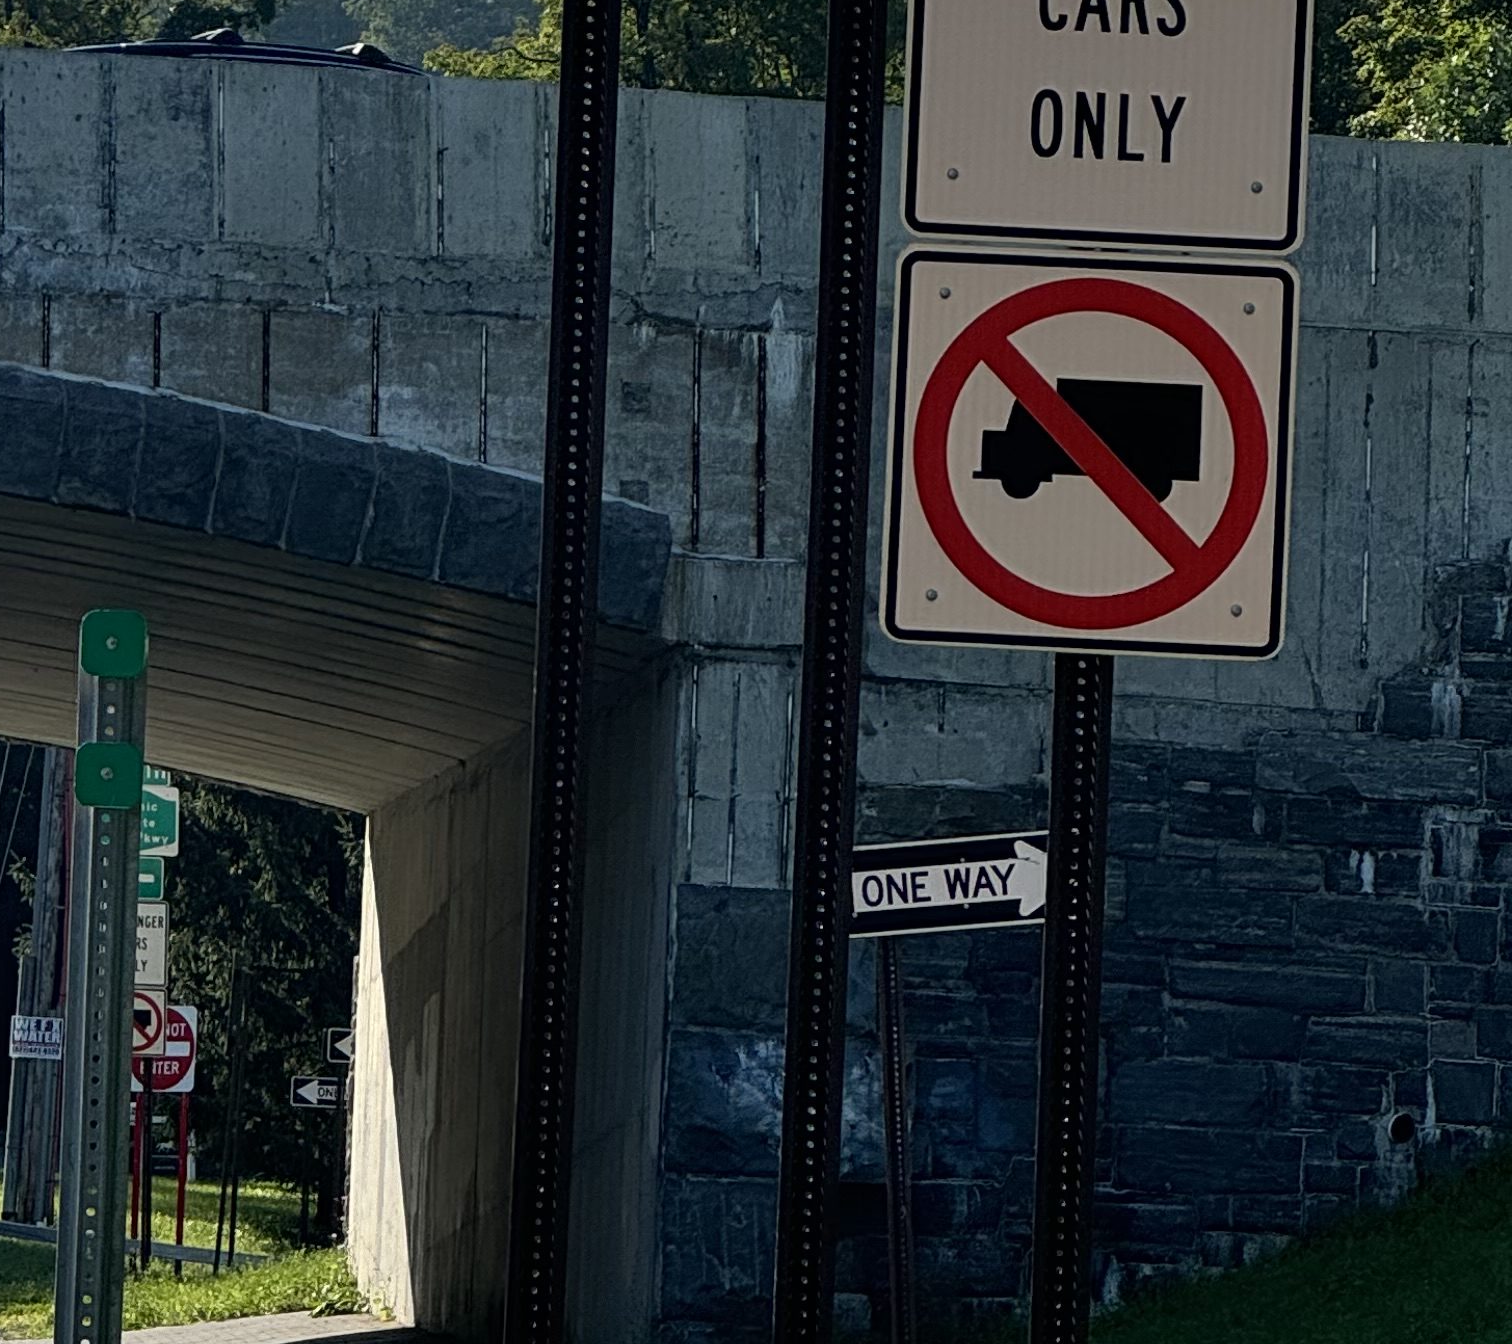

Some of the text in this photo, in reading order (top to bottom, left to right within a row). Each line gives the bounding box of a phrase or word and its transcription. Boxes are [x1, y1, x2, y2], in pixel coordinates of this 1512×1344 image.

[1029, 88, 1186, 164] ONLY
[140, 832, 169, 845] kwy
[861, 863, 1016, 907] ONE WAY
[135, 937, 148, 950] RS
[317, 1086, 338, 1098] ON
